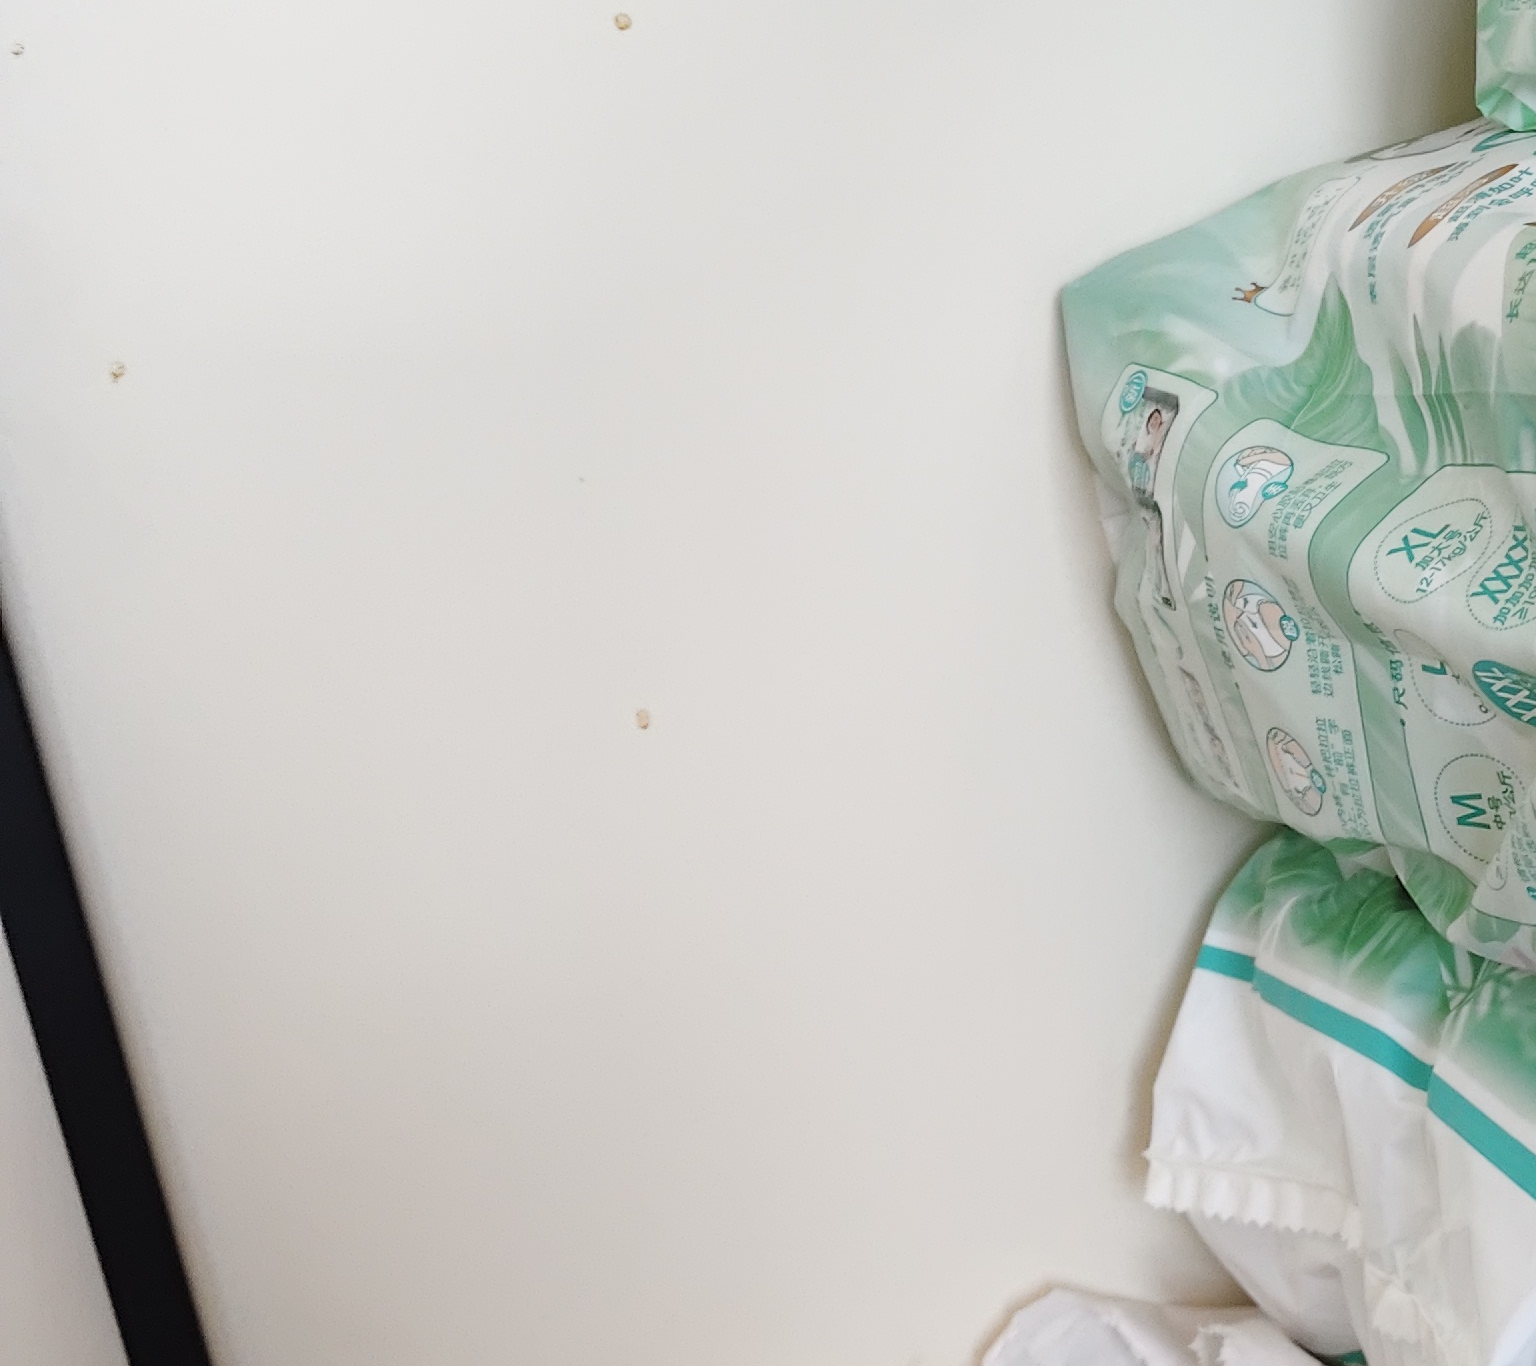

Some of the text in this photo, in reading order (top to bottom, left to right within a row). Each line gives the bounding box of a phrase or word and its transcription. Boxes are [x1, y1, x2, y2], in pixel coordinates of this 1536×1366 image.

[1385, 524, 1448, 565] XL
[1413, 528, 1462, 571] 加大号
[1450, 792, 1490, 829] M
